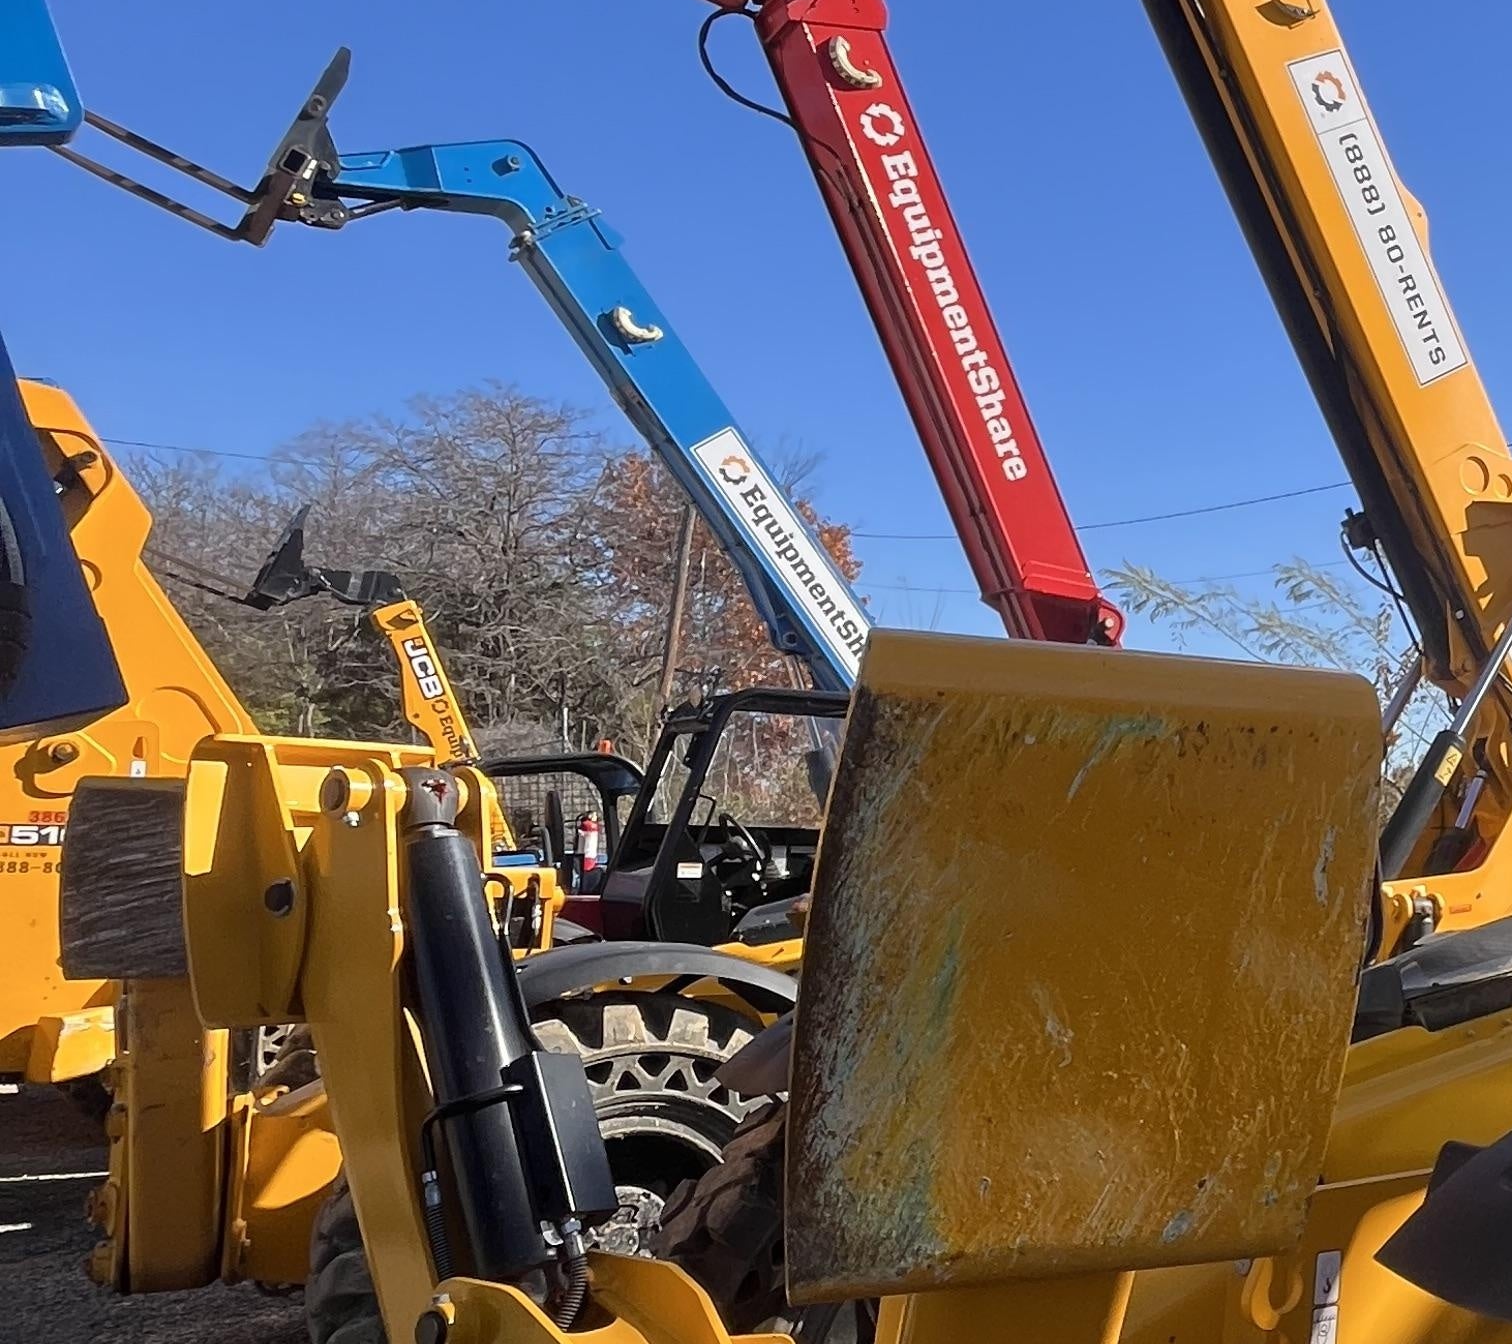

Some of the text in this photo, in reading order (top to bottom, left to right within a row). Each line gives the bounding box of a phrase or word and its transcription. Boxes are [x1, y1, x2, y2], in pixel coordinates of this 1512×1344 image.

[881, 150, 1027, 481] EquipmentShare
[1339, 133, 1447, 366] (888) 80-RENTS
[740, 484, 866, 657] EquipmentSh
[403, 639, 444, 699] JCB
[10, 825, 66, 845] 51
